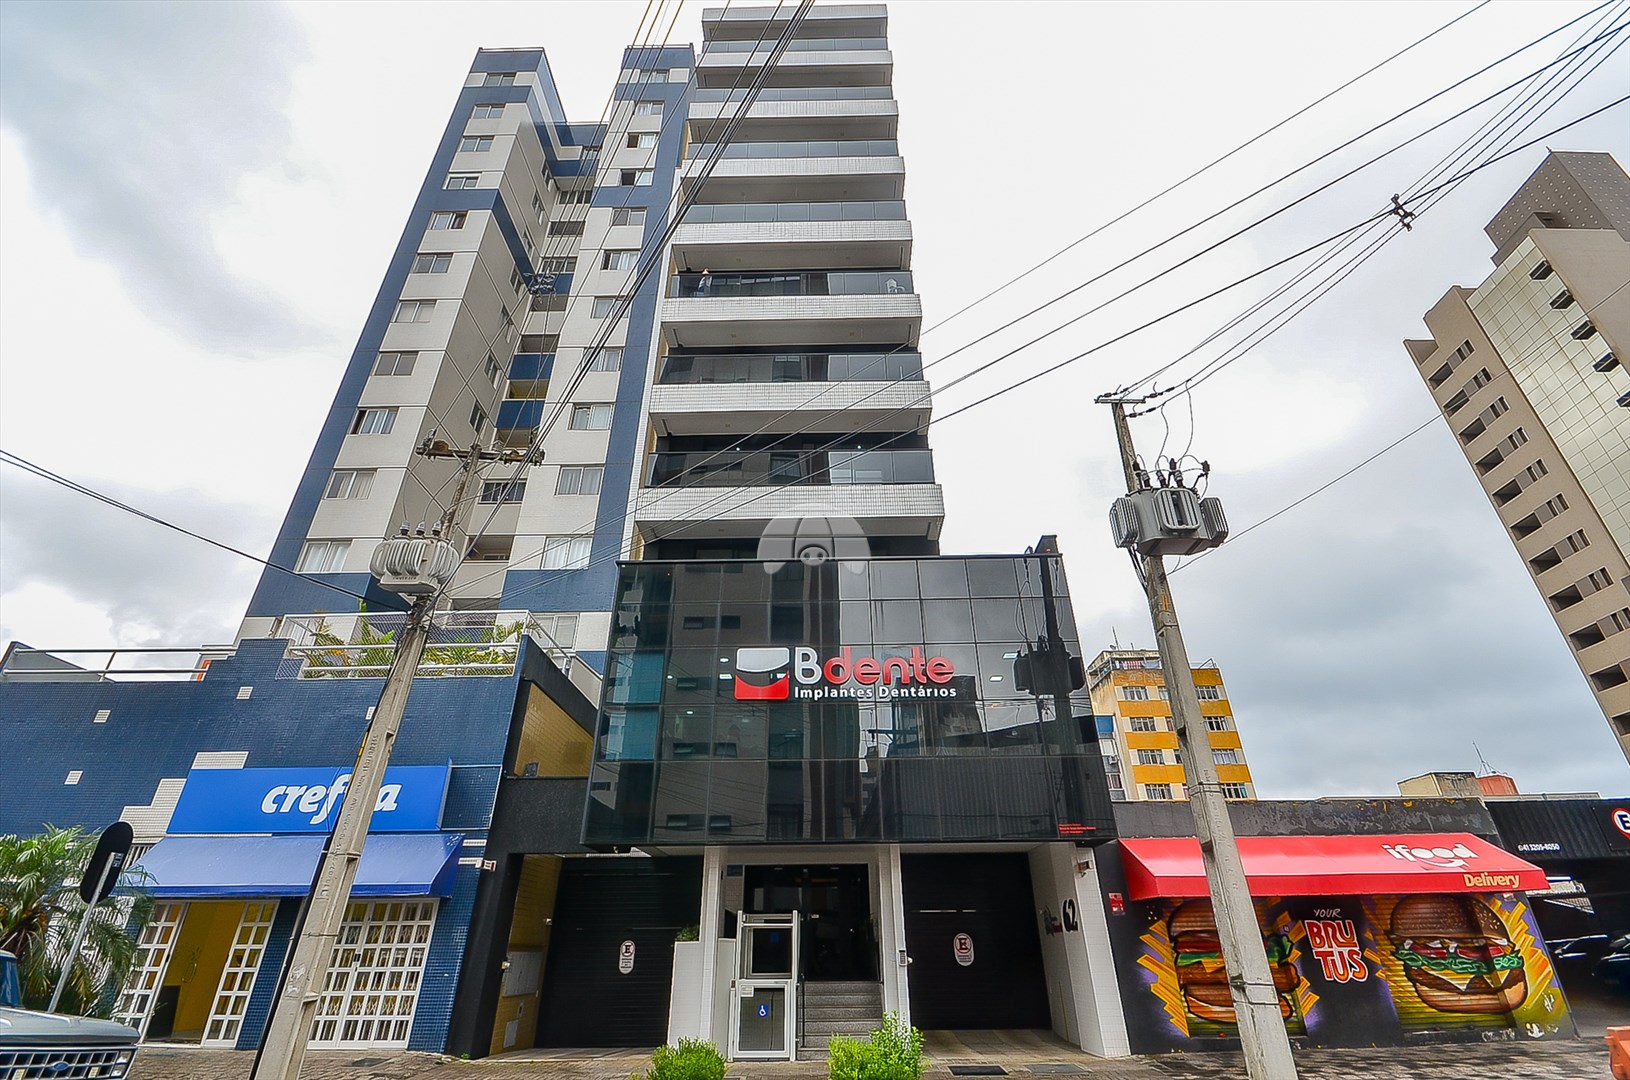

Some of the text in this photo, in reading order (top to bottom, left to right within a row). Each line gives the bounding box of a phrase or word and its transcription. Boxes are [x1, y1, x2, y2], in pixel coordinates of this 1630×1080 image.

[794, 646, 955, 685] Bdente
[794, 684, 957, 701] Implantes Dentários
[261, 774, 402, 824] crefa
[1463, 872, 1520, 889] Delivery
[1062, 898, 1079, 933] 62
[1313, 908, 1342, 919] YOUR
[1305, 920, 1360, 950] BRU
[1313, 949, 1369, 984] TUS
